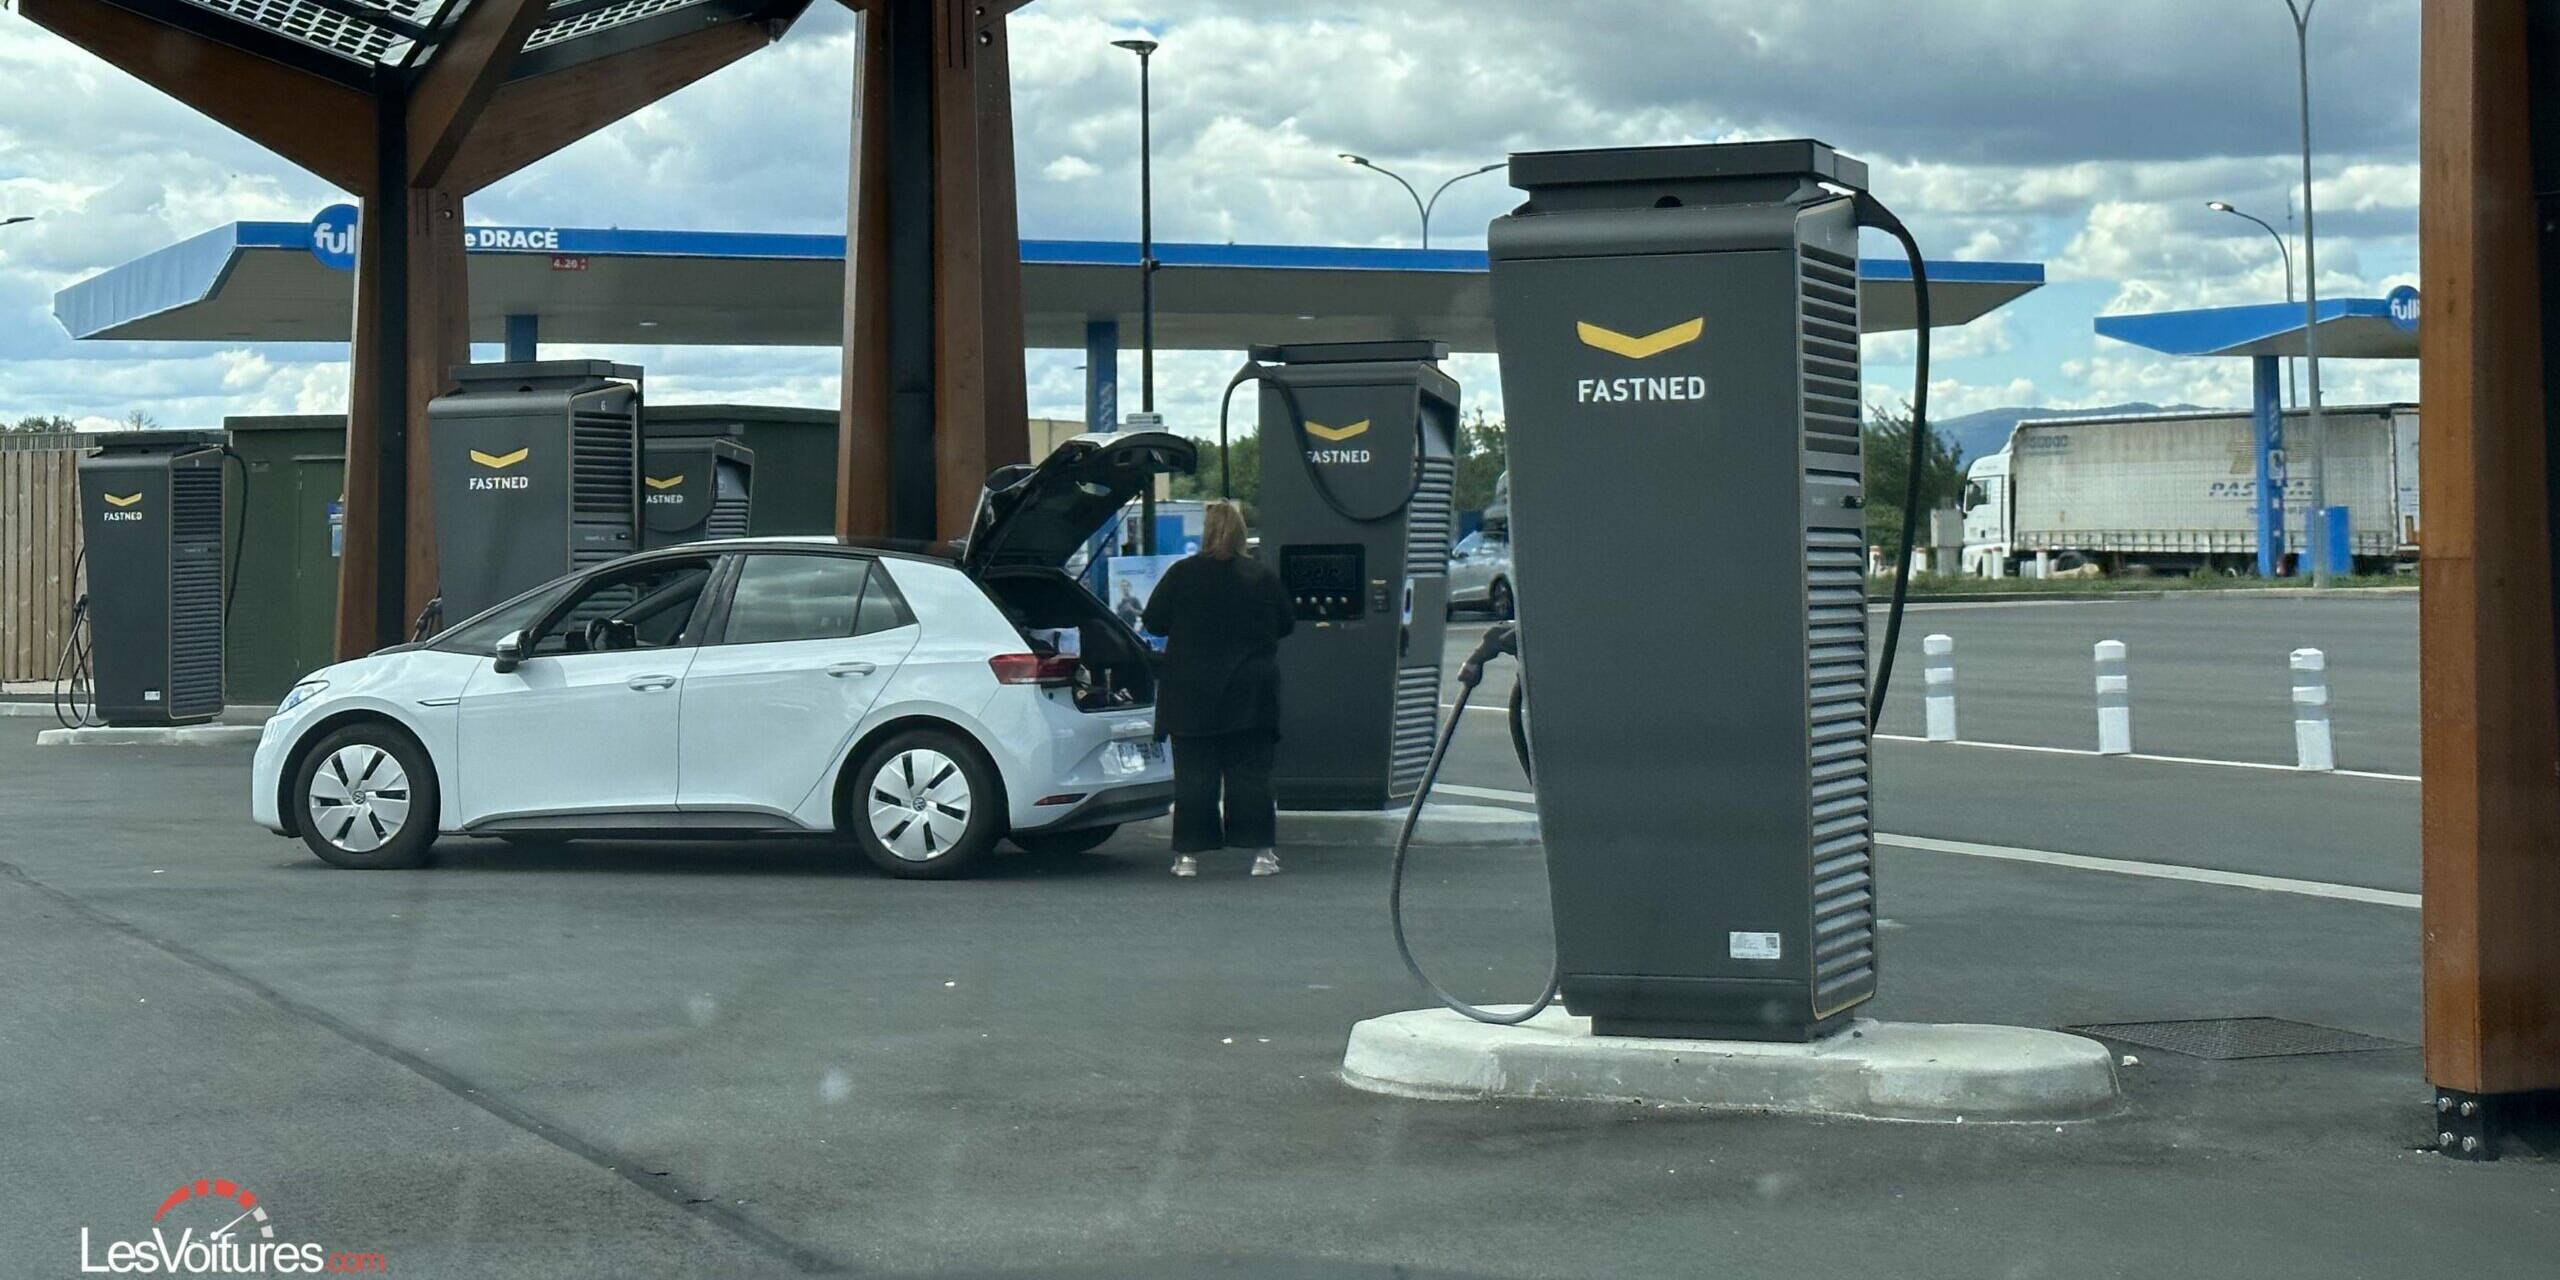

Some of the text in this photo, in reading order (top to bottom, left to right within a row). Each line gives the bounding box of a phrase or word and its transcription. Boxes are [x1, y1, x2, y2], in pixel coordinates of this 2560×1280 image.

[313, 222, 355, 254] ful
[465, 227, 558, 249] e DRACÉ
[1578, 376, 1706, 402] FASTNED
[469, 476, 528, 490] FASTNED
[646, 494, 684, 504] ASTNED
[104, 511, 142, 521] FASTNED
